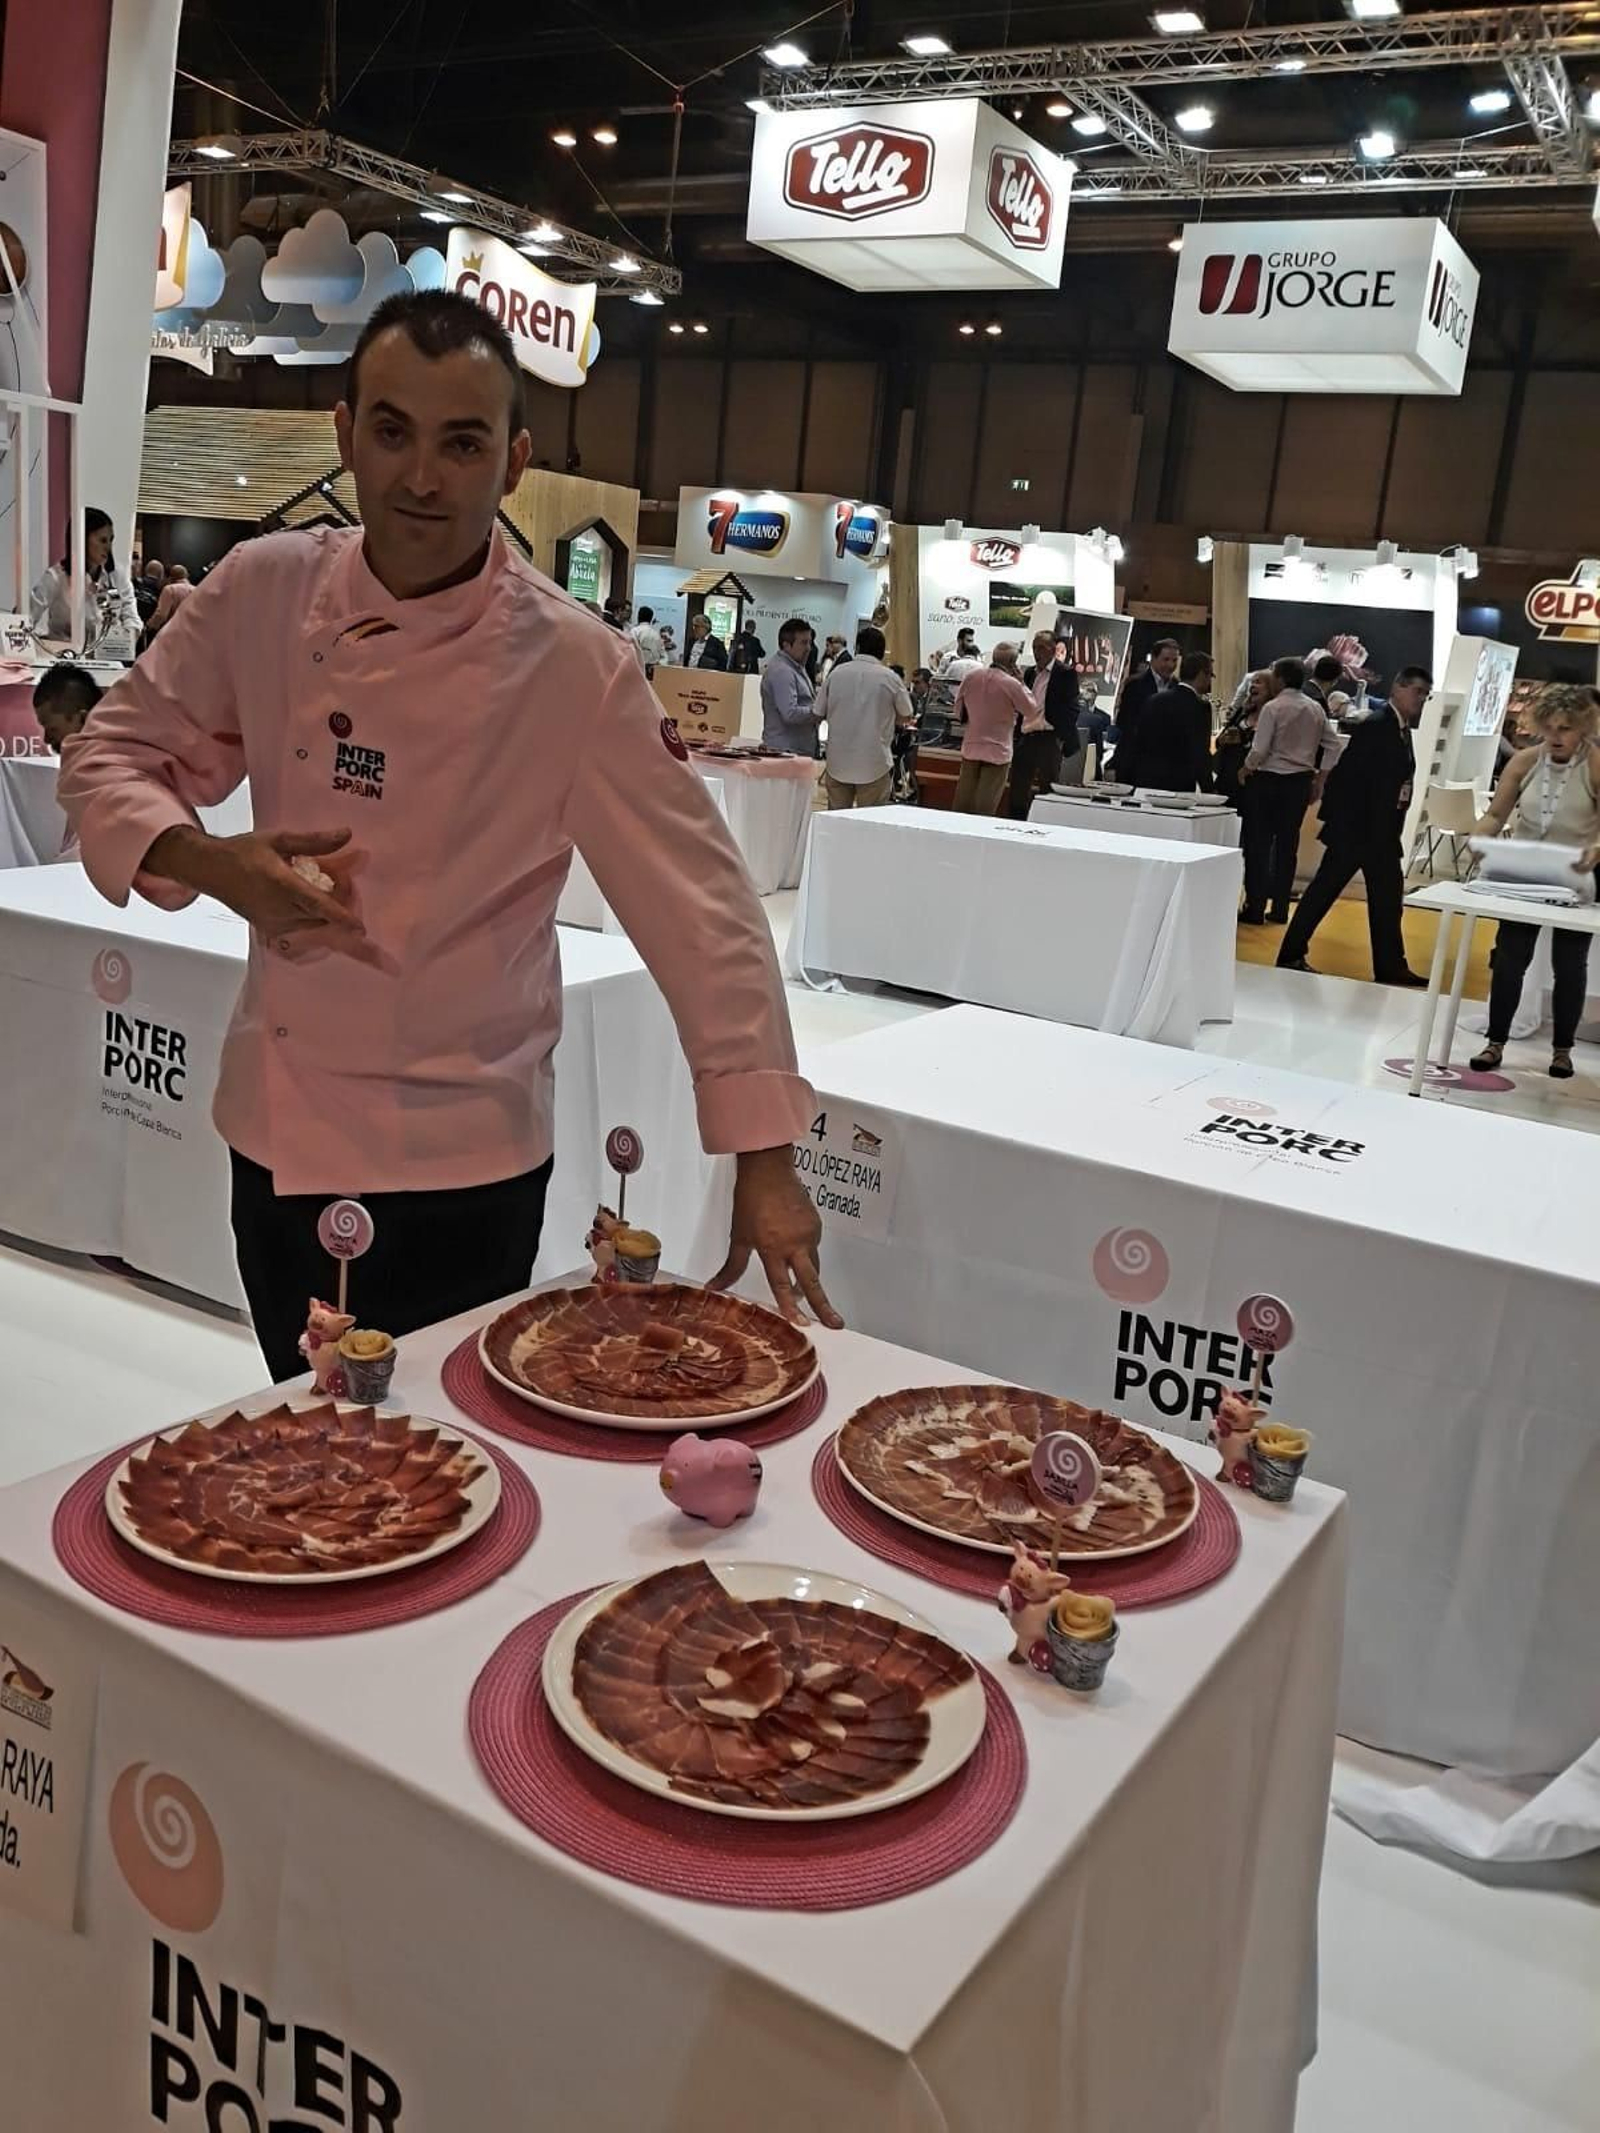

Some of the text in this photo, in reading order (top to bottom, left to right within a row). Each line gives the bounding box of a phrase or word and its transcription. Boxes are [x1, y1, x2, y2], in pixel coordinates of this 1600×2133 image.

[810, 140, 912, 197] Tello
[999, 158, 1045, 227] Tello
[1267, 251, 1336, 268] GRUPO
[1258, 270, 1396, 319] JORGE
[1438, 296, 1469, 349] JORGE
[709, 500, 782, 556] 7 HERMANOS
[836, 502, 855, 559] 7
[976, 541, 1015, 563] Tello
[1533, 590, 1600, 620] eLP
[13, 736, 41, 757] DE
[336, 742, 386, 767] INTER
[332, 776, 383, 800] SPAIN
[334, 759, 385, 783] PORC
[105, 1010, 187, 1066] INTER
[104, 1045, 186, 1102] PORC
[810, 1112, 827, 1142] 4
[1200, 1122, 1361, 1163] PORC
[1214, 1114, 1366, 1154] INTER
[793, 1146, 882, 1194] DO LÓPEZ RAYA
[816, 1184, 861, 1219] Granada.
[1, 1738, 54, 1814] RAYA
[151, 1938, 402, 2133] INTER
